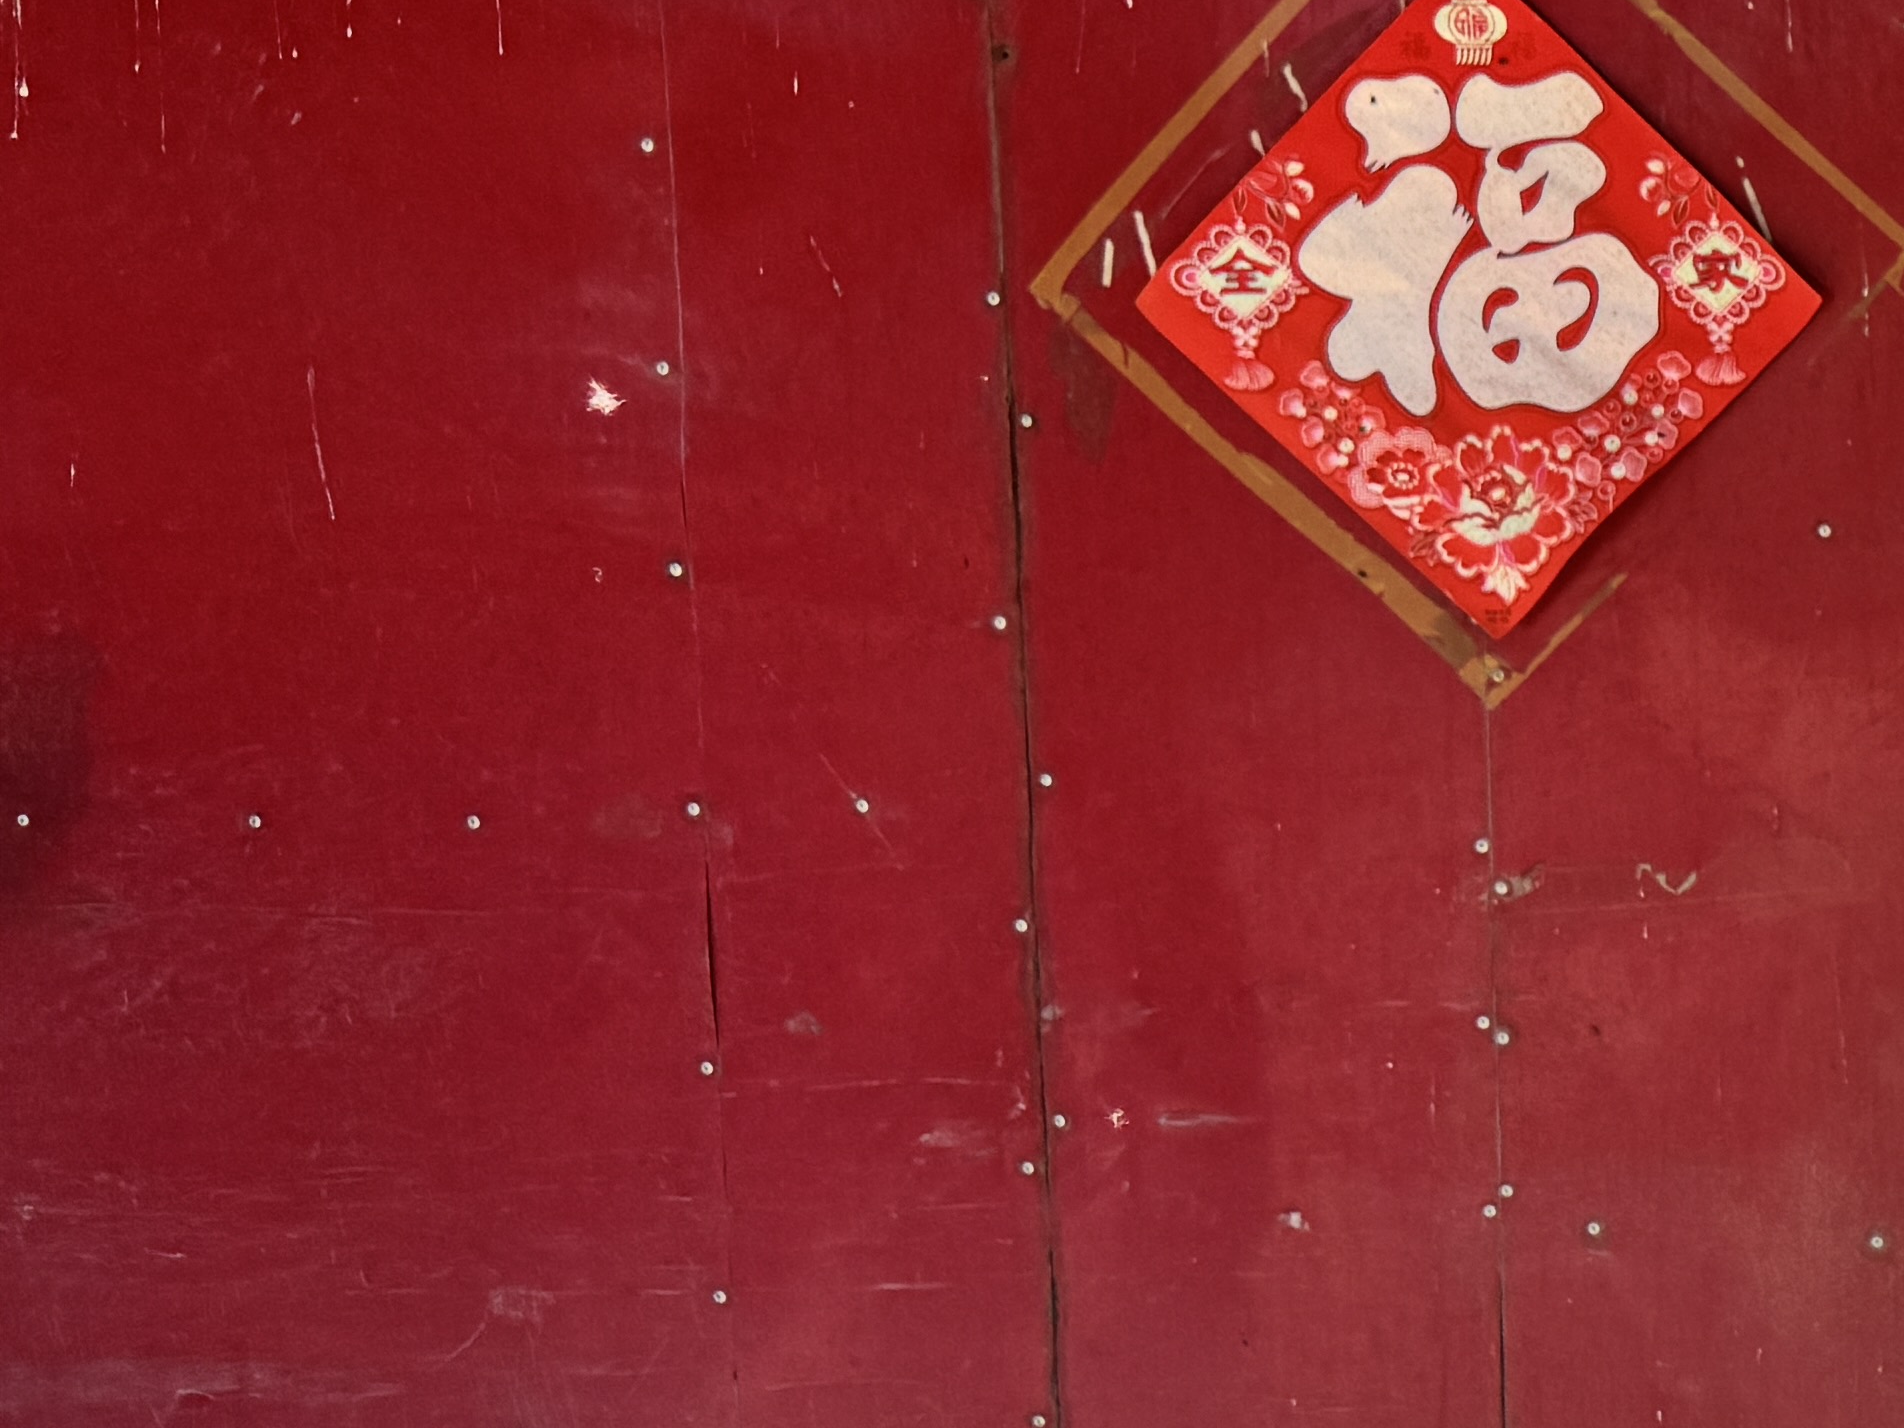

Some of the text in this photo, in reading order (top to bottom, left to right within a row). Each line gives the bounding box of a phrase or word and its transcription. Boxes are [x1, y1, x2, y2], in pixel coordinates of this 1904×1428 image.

[1299, 71, 1660, 416] 福
[1208, 248, 1279, 295] 全
[1688, 249, 1749, 292] 家
